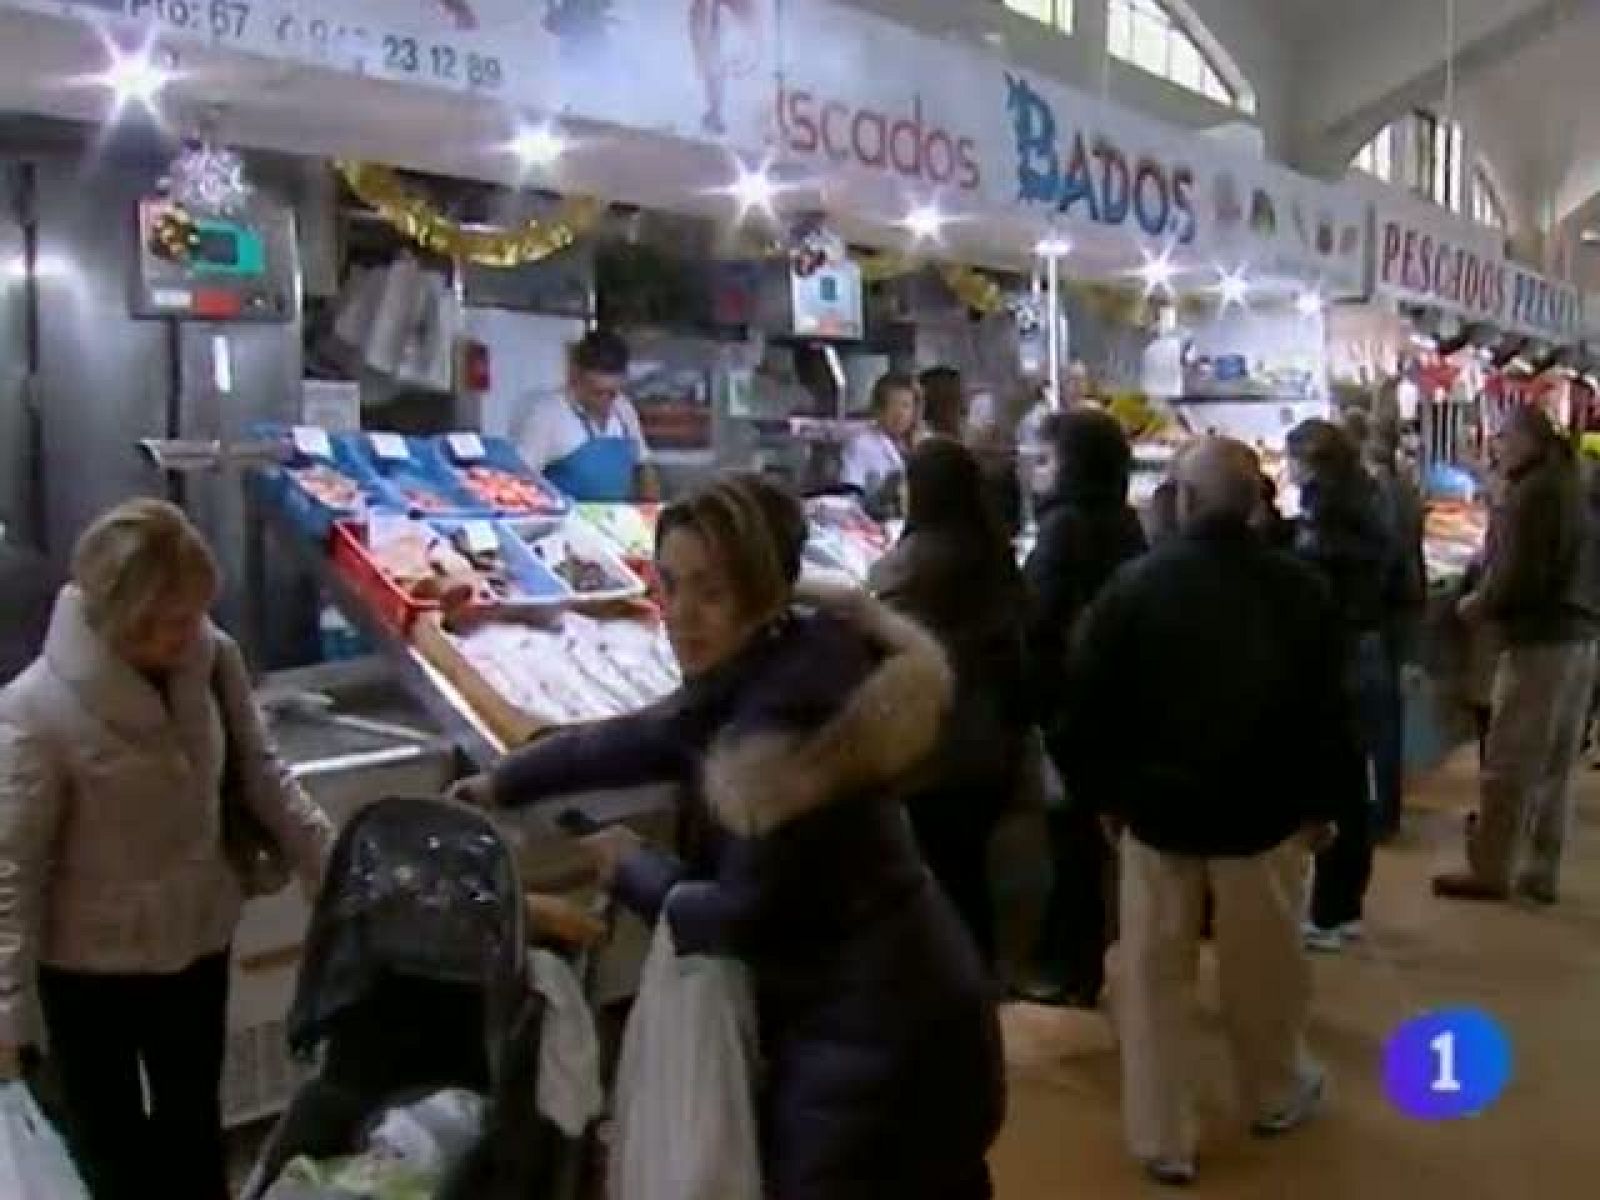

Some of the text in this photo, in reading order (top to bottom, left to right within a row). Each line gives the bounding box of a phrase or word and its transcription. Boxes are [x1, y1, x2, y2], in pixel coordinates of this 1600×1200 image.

[383, 34, 418, 72] 23
[429, 44, 458, 80] 12
[1003, 72, 1196, 245] BADOS
